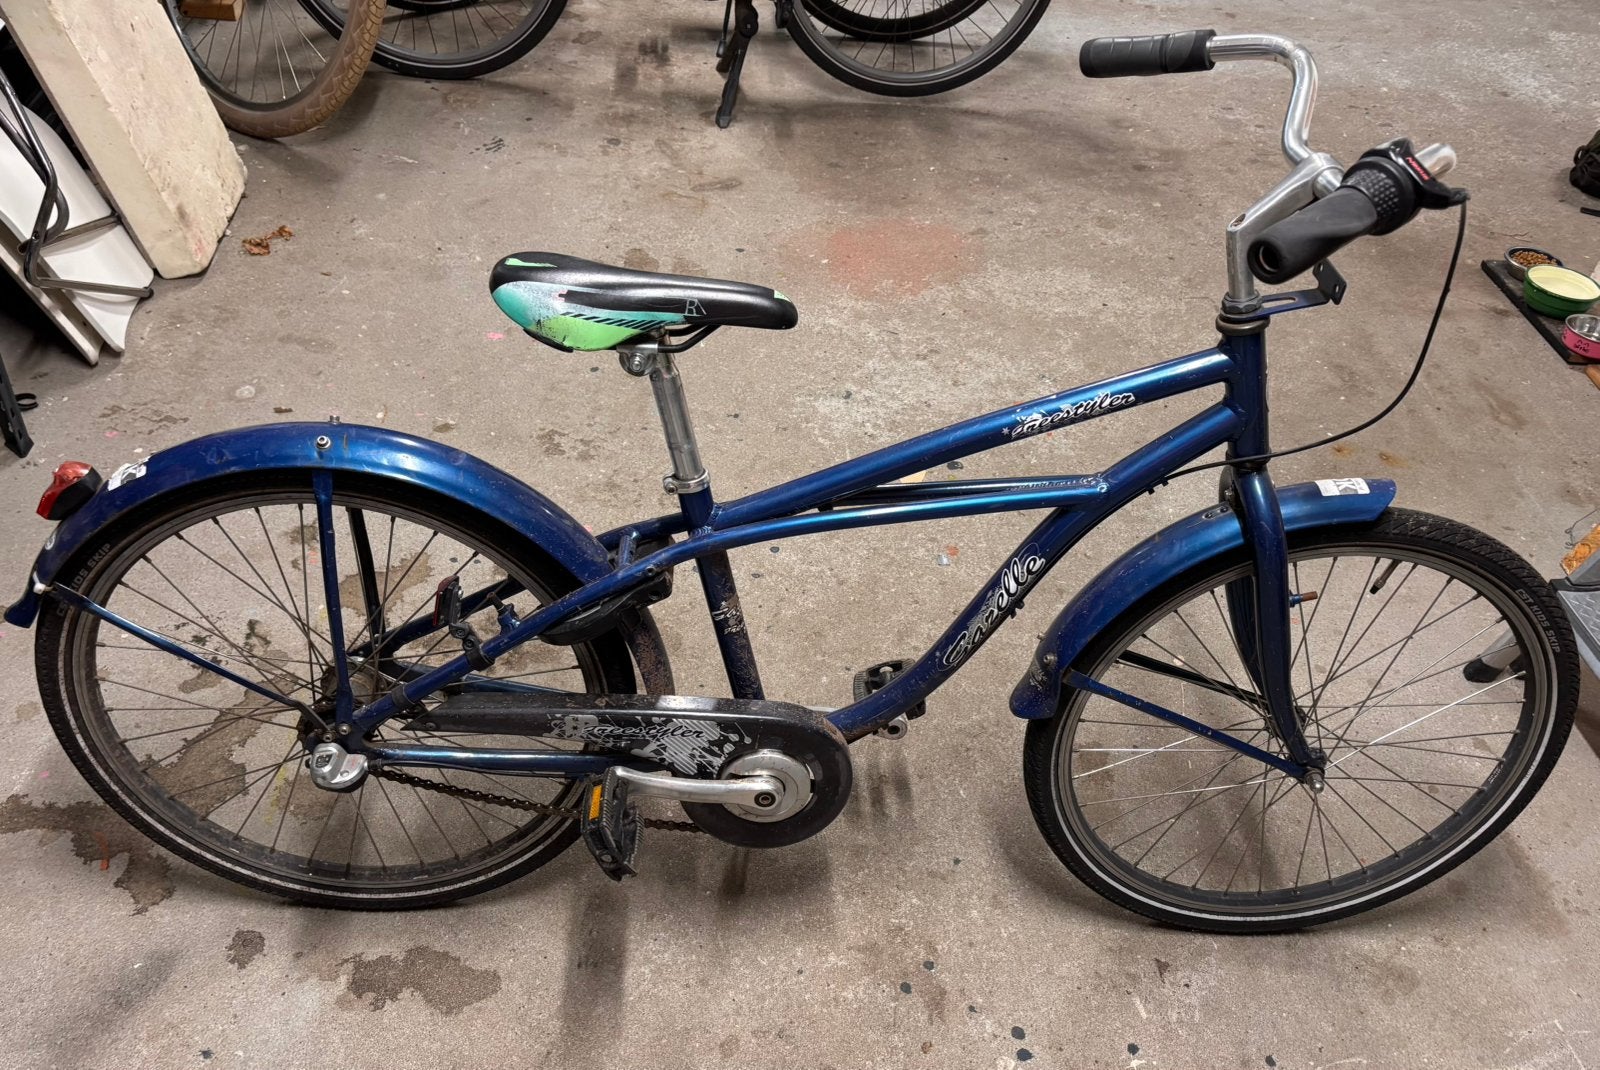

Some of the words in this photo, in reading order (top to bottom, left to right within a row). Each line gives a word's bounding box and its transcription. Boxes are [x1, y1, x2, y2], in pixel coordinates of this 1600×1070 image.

[88, 543, 112, 567] SKIP
[942, 555, 1046, 666] Gazelle
[1515, 588, 1535, 604] CST
[1530, 605, 1550, 627] KIDS
[1546, 629, 1561, 653] SKIP
